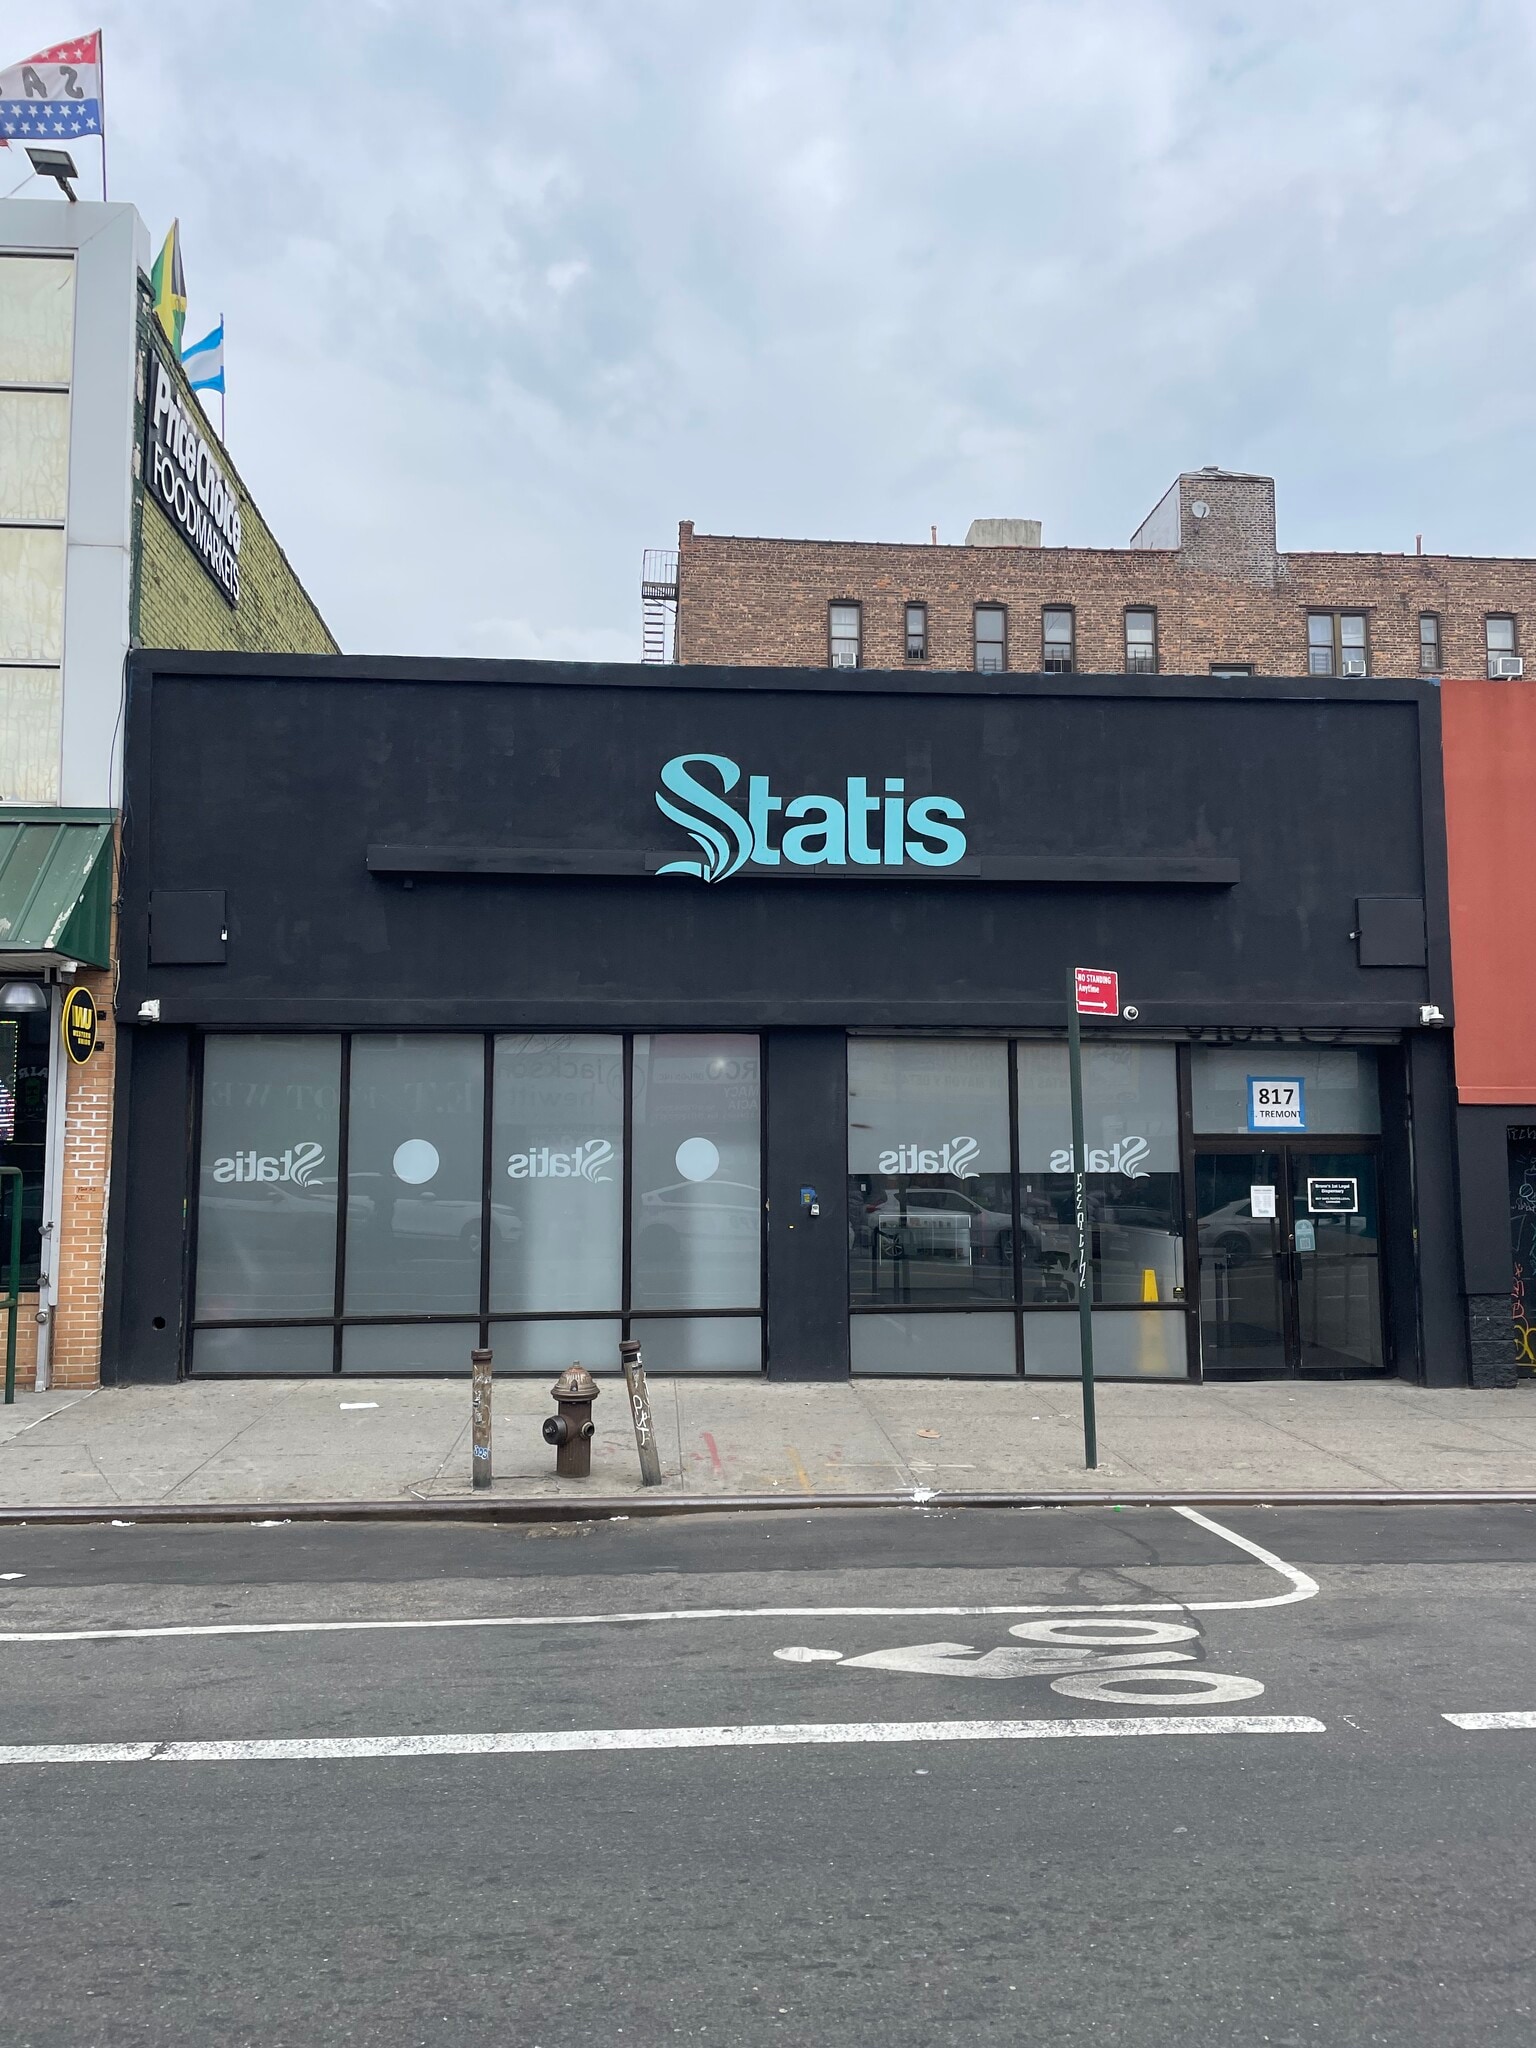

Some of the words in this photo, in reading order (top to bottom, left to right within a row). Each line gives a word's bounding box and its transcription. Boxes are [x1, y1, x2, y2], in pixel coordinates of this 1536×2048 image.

[654, 752, 968, 884] Statis
[1077, 973, 1086, 983] NO
[1086, 974, 1112, 985] STANDING
[1078, 983, 1100, 995] Anytime
[71, 1004, 93, 1030] WU
[1258, 1087, 1295, 1105] 817
[1259, 1110, 1302, 1119] TREMONT
